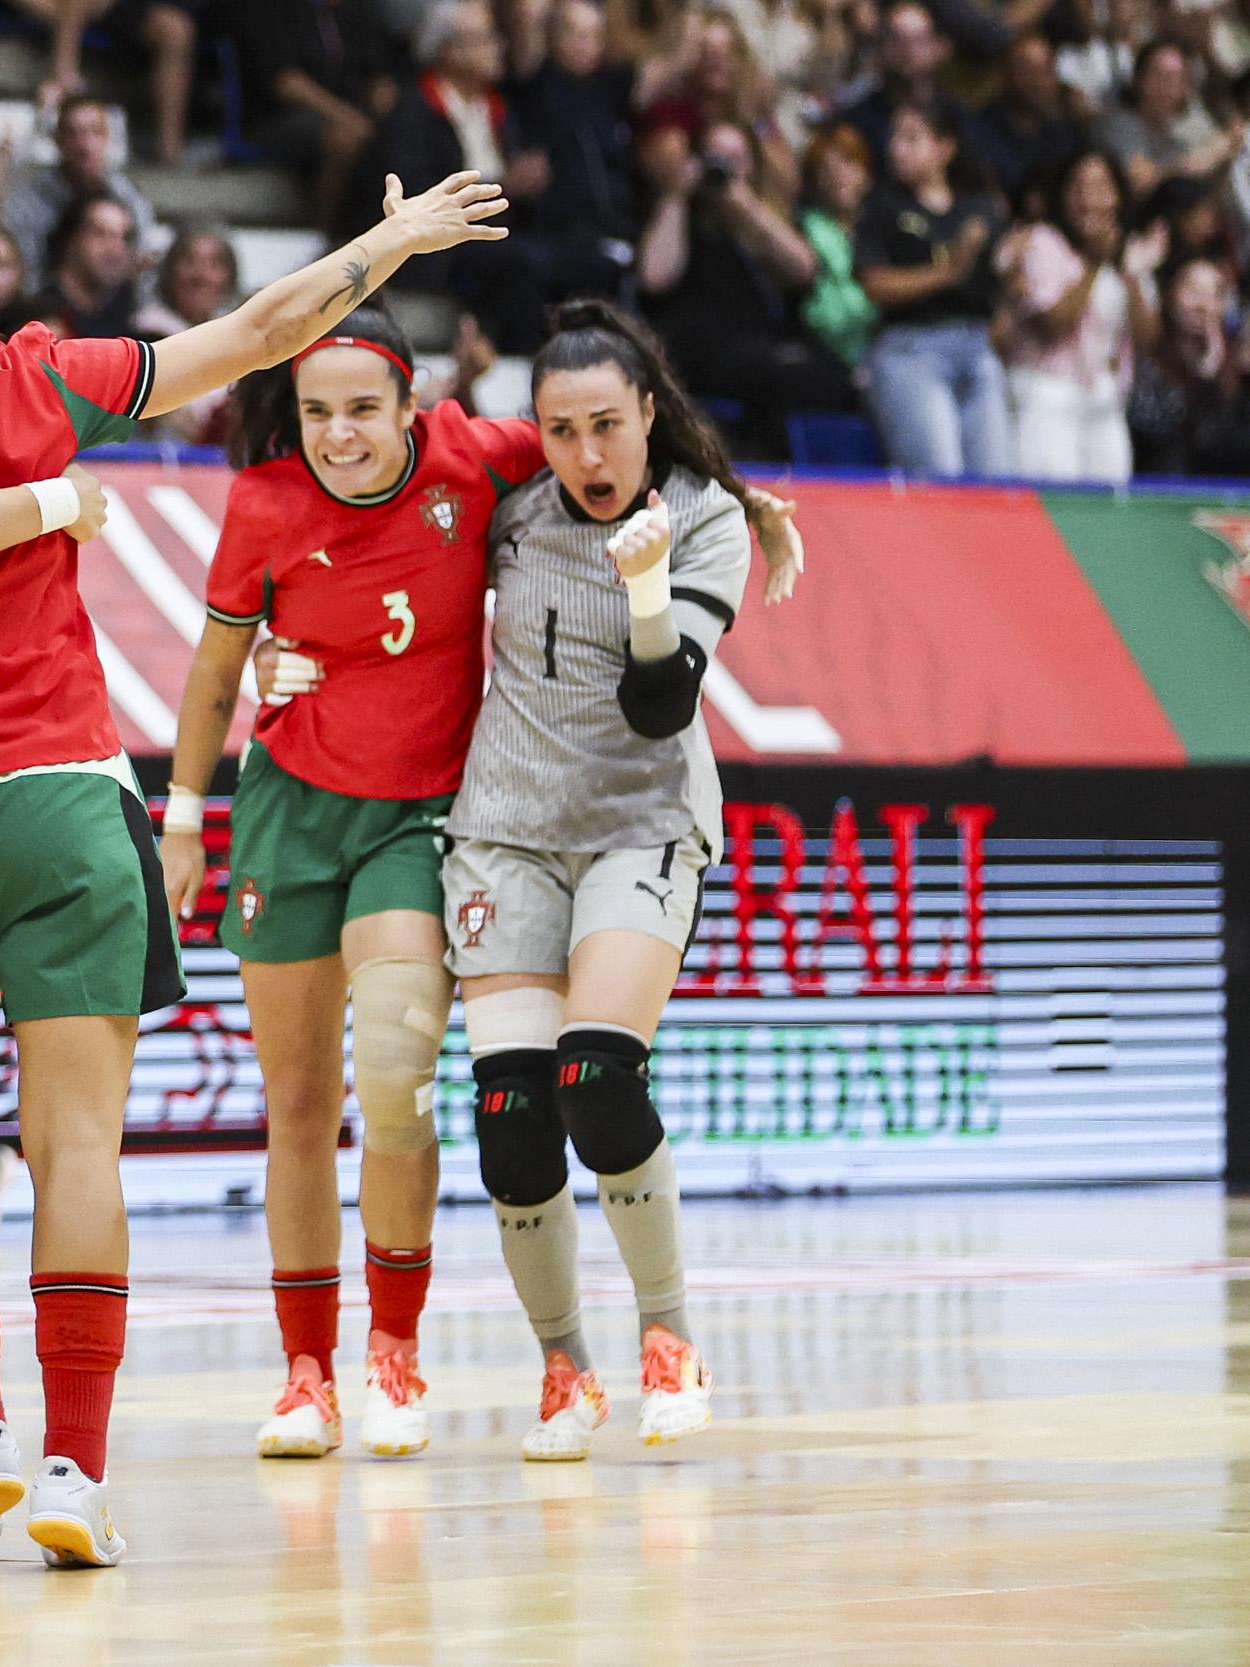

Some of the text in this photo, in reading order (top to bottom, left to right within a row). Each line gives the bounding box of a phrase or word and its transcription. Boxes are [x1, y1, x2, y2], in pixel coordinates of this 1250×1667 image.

[381, 589, 416, 656] 3
[543, 608, 559, 680] 1
[675, 798, 996, 996] RALI
